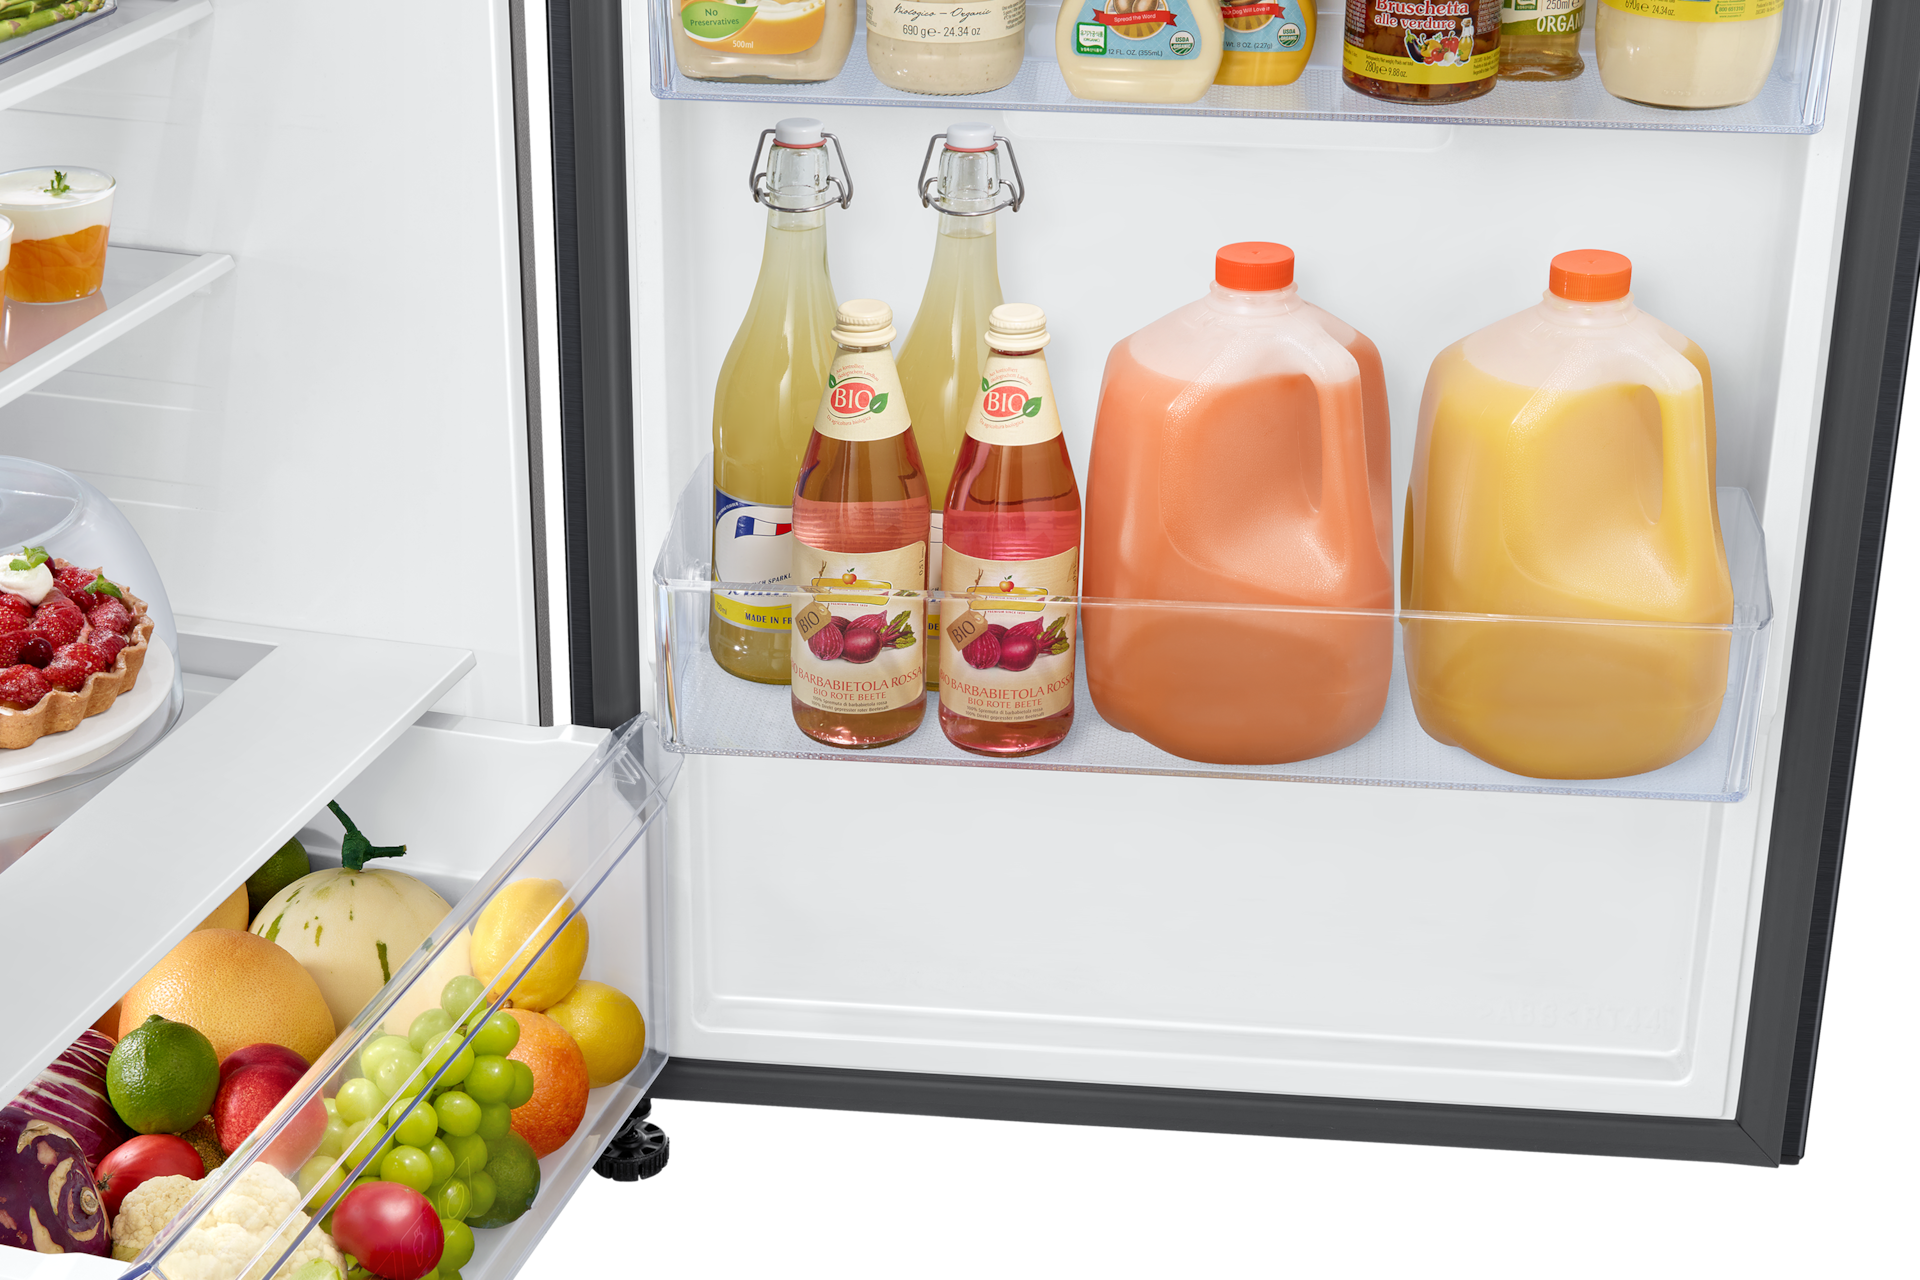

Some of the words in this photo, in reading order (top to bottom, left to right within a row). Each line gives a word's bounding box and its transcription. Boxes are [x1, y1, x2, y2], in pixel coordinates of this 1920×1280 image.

[704, 8, 718, 16] No
[1376, 0, 1469, 14] Bruschetta
[690, 18, 740, 26] Preservatives
[950, 7, 992, 23] Organic
[1374, 14, 1398, 26] alle
[1401, 17, 1455, 29] verdure
[902, 24, 919, 36] 690
[943, 26, 969, 37] 24.34
[971, 27, 981, 35] oz
[732, 40, 754, 48] 500ml
[834, 388, 873, 410] BIO
[987, 391, 1027, 413] BIO
[768, 572, 792, 584] SPARKL
[745, 613, 767, 624] MADE
[770, 616, 779, 624] IN
[798, 611, 820, 633] BIO
[951, 620, 976, 643] BIO
[798, 667, 889, 692] BARBABIETOLA
[891, 666, 922, 688] ROSSA
[813, 687, 828, 697] BIO
[830, 692, 855, 701] ROTE
[858, 692, 887, 701] BEETE
[951, 678, 1045, 700] BARBABIETOLA
[967, 697, 984, 706] BIO
[986, 700, 1012, 709] ROTE
[1014, 698, 1042, 709] BEETE
